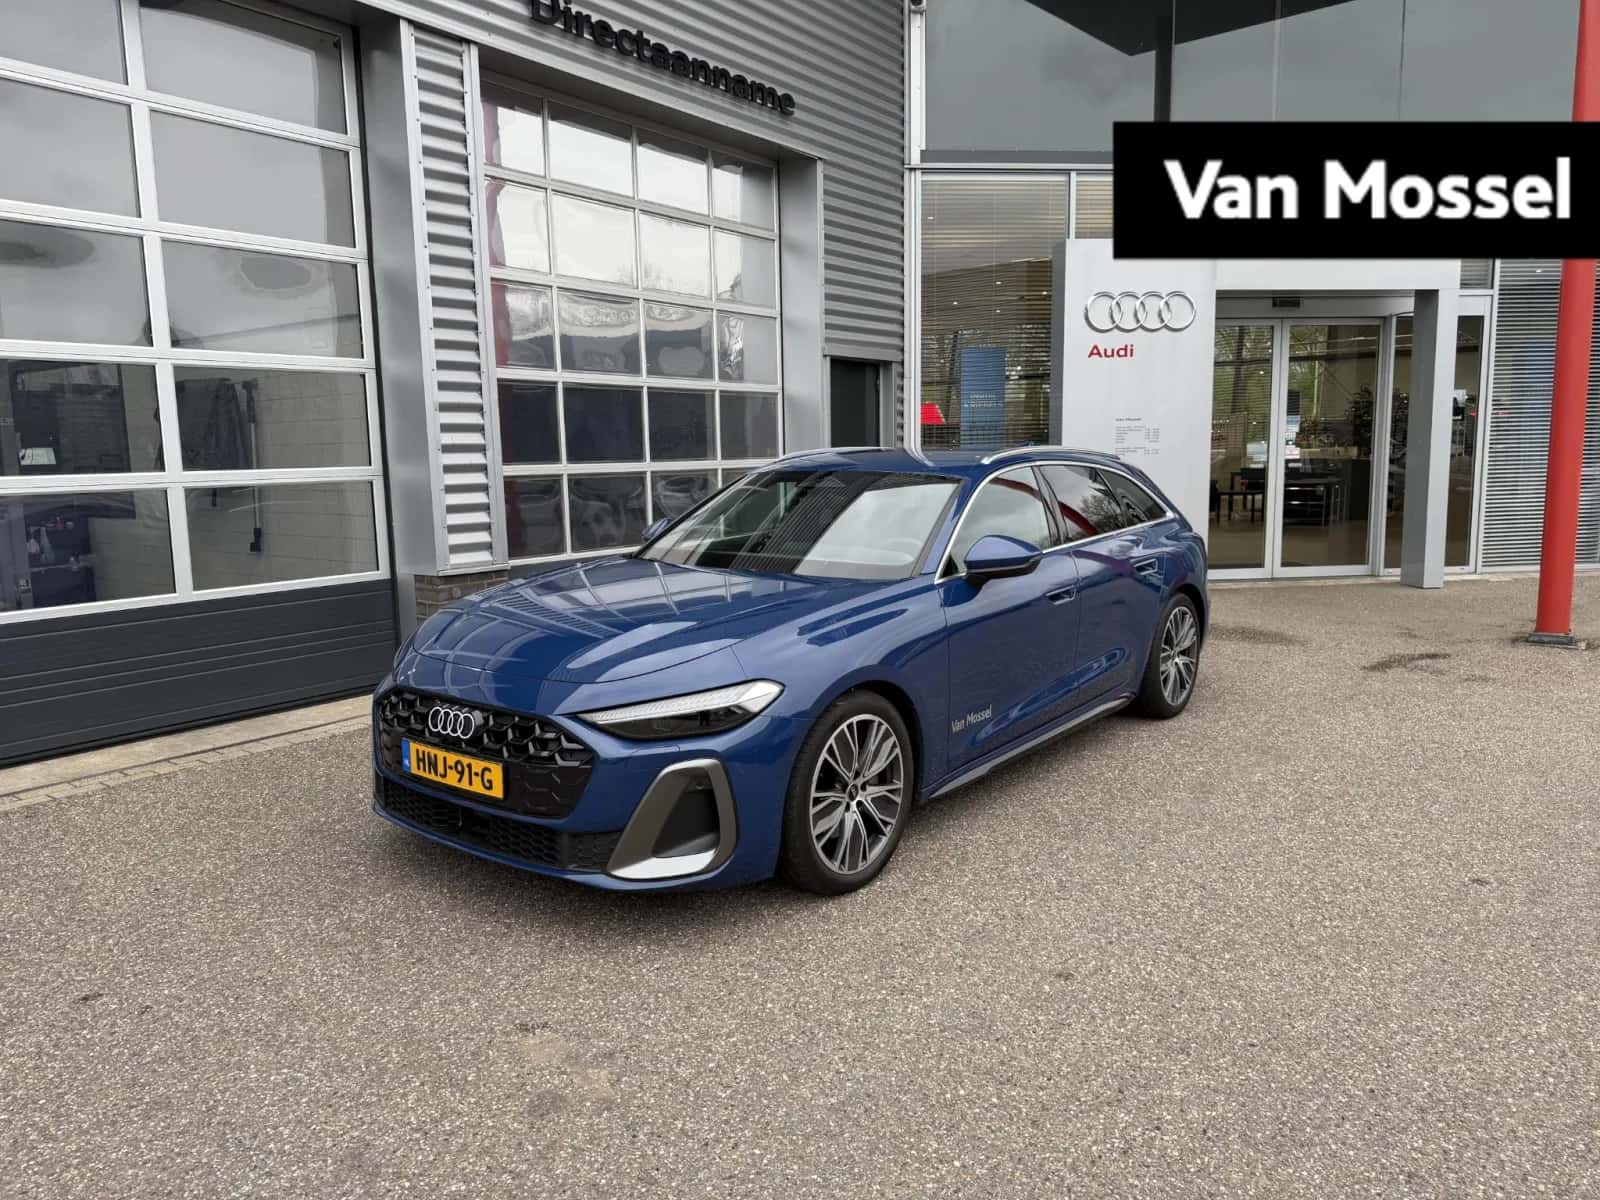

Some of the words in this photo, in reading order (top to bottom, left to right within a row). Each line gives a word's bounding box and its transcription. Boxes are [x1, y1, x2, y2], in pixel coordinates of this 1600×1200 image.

[530, 0, 796, 116] Directaanname
[1087, 344, 1135, 358] Audi
[951, 719, 965, 733] Van
[966, 704, 992, 726] Mossel
[416, 749, 493, 791] HNJ-91-G
